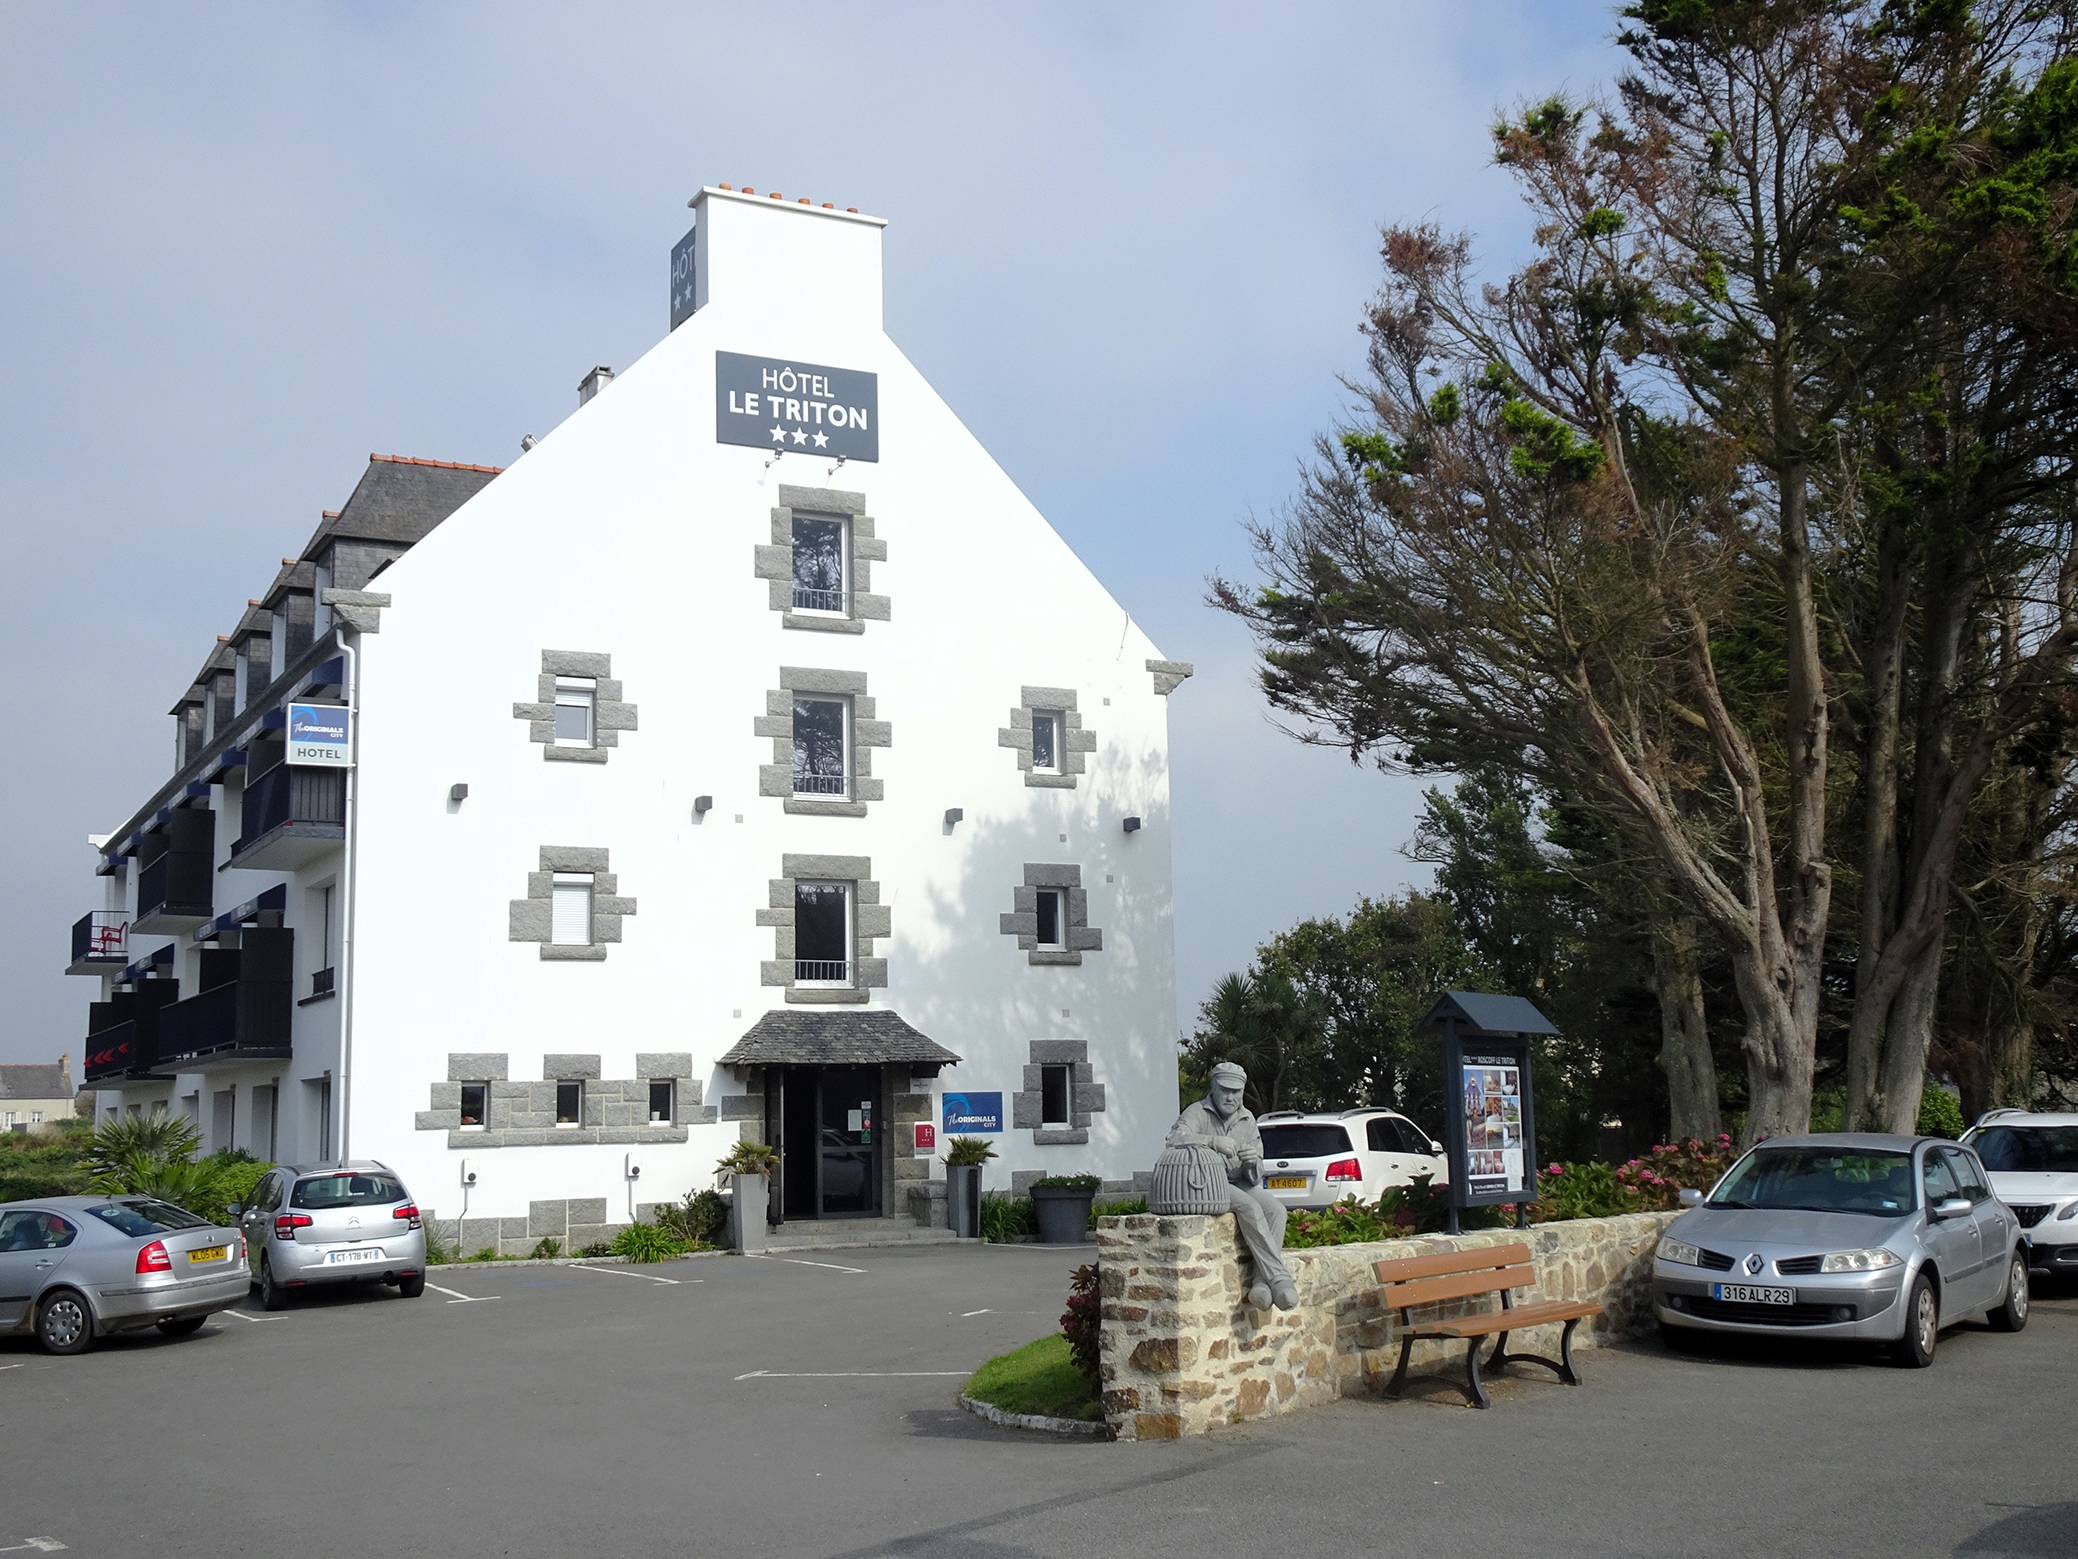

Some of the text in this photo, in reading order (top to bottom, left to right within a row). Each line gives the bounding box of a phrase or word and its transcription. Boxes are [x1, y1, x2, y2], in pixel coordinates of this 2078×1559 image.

[672, 244, 696, 288] HÔT
[762, 366, 835, 398] HÔTEL
[729, 390, 868, 430] LE TRITON
[297, 747, 341, 759] HOTEL
[957, 1115, 997, 1123] ORIGINALS
[925, 1128, 933, 1137] H
[1724, 1286, 1747, 1300] 316
[1748, 1288, 1772, 1302] ALR
[1773, 1290, 1790, 1304] 29
